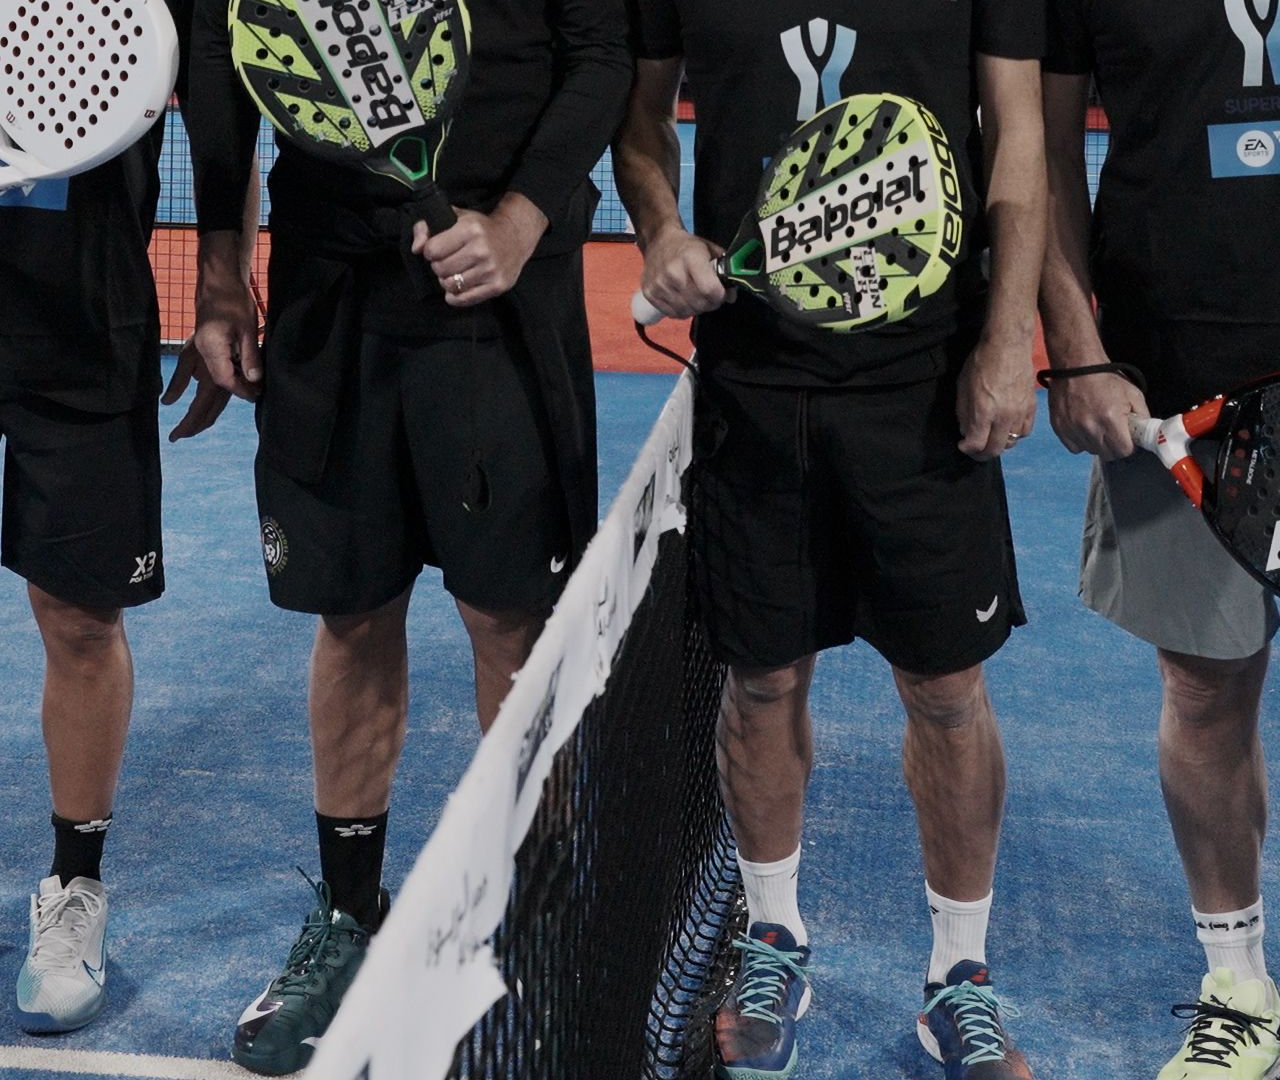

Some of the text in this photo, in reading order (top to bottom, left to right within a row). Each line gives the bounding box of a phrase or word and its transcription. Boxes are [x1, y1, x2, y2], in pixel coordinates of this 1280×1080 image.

[917, 104, 964, 266] abolat
[1244, 138, 1268, 151] EA
[770, 155, 929, 260] Babolat
